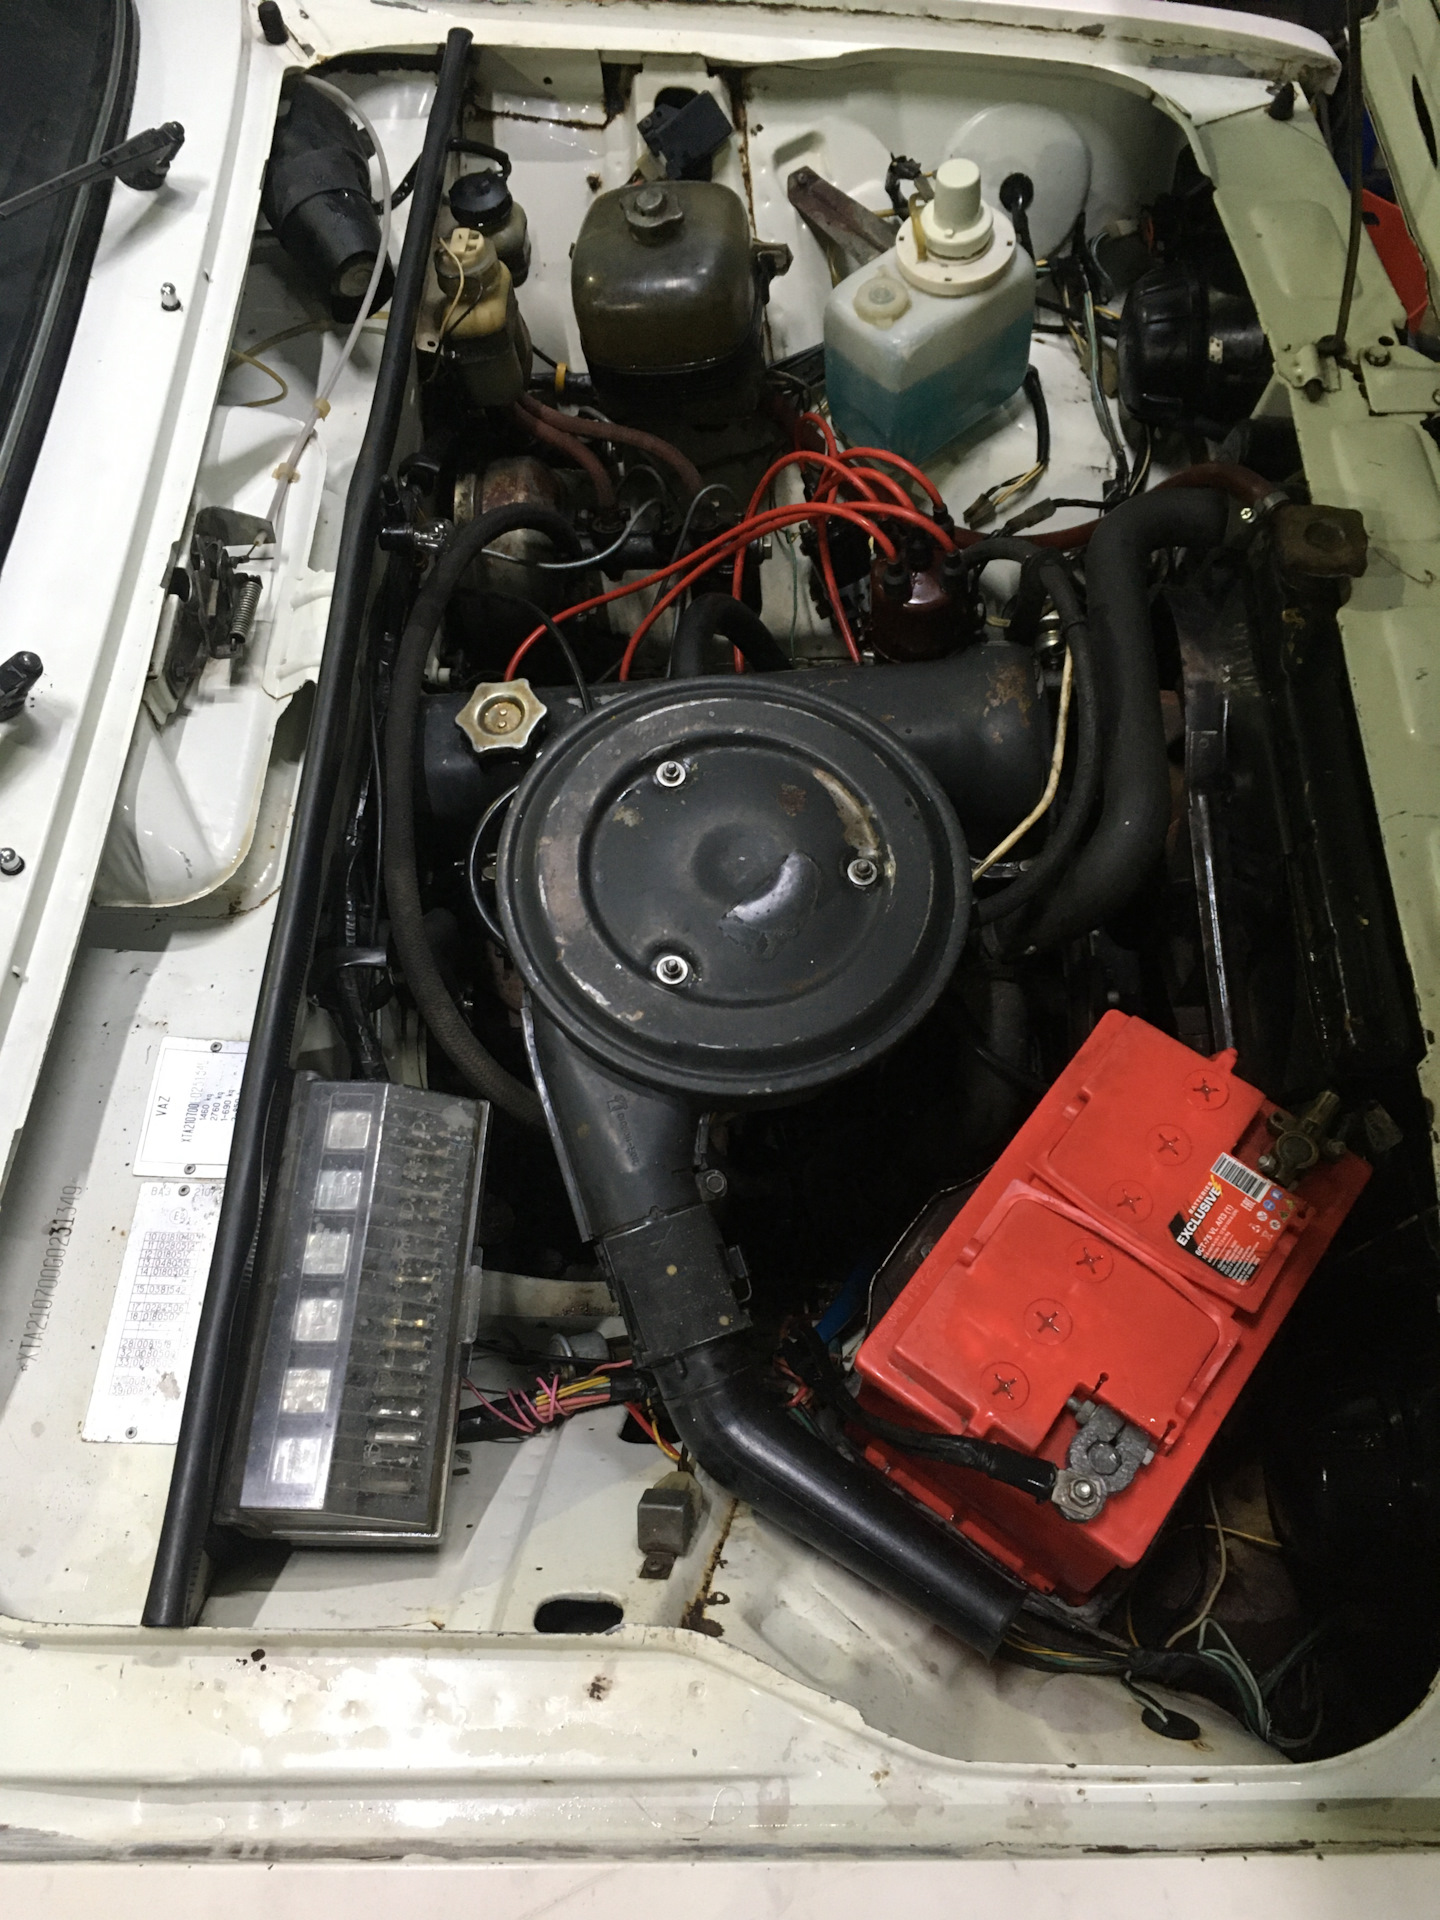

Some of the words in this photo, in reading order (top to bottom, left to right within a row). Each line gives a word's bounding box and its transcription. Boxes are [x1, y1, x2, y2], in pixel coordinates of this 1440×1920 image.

[224, 1089, 235, 1097] kg
[155, 1095, 170, 1116] VAZ
[199, 1104, 210, 1120] 1460
[210, 1102, 221, 1121] 2760
[221, 1100, 232, 1121] 1-690
[1175, 1185, 1222, 1246] EXCLUSIVE
[137, 1285, 144, 1293] 15
[131, 1312, 138, 1320] 18
